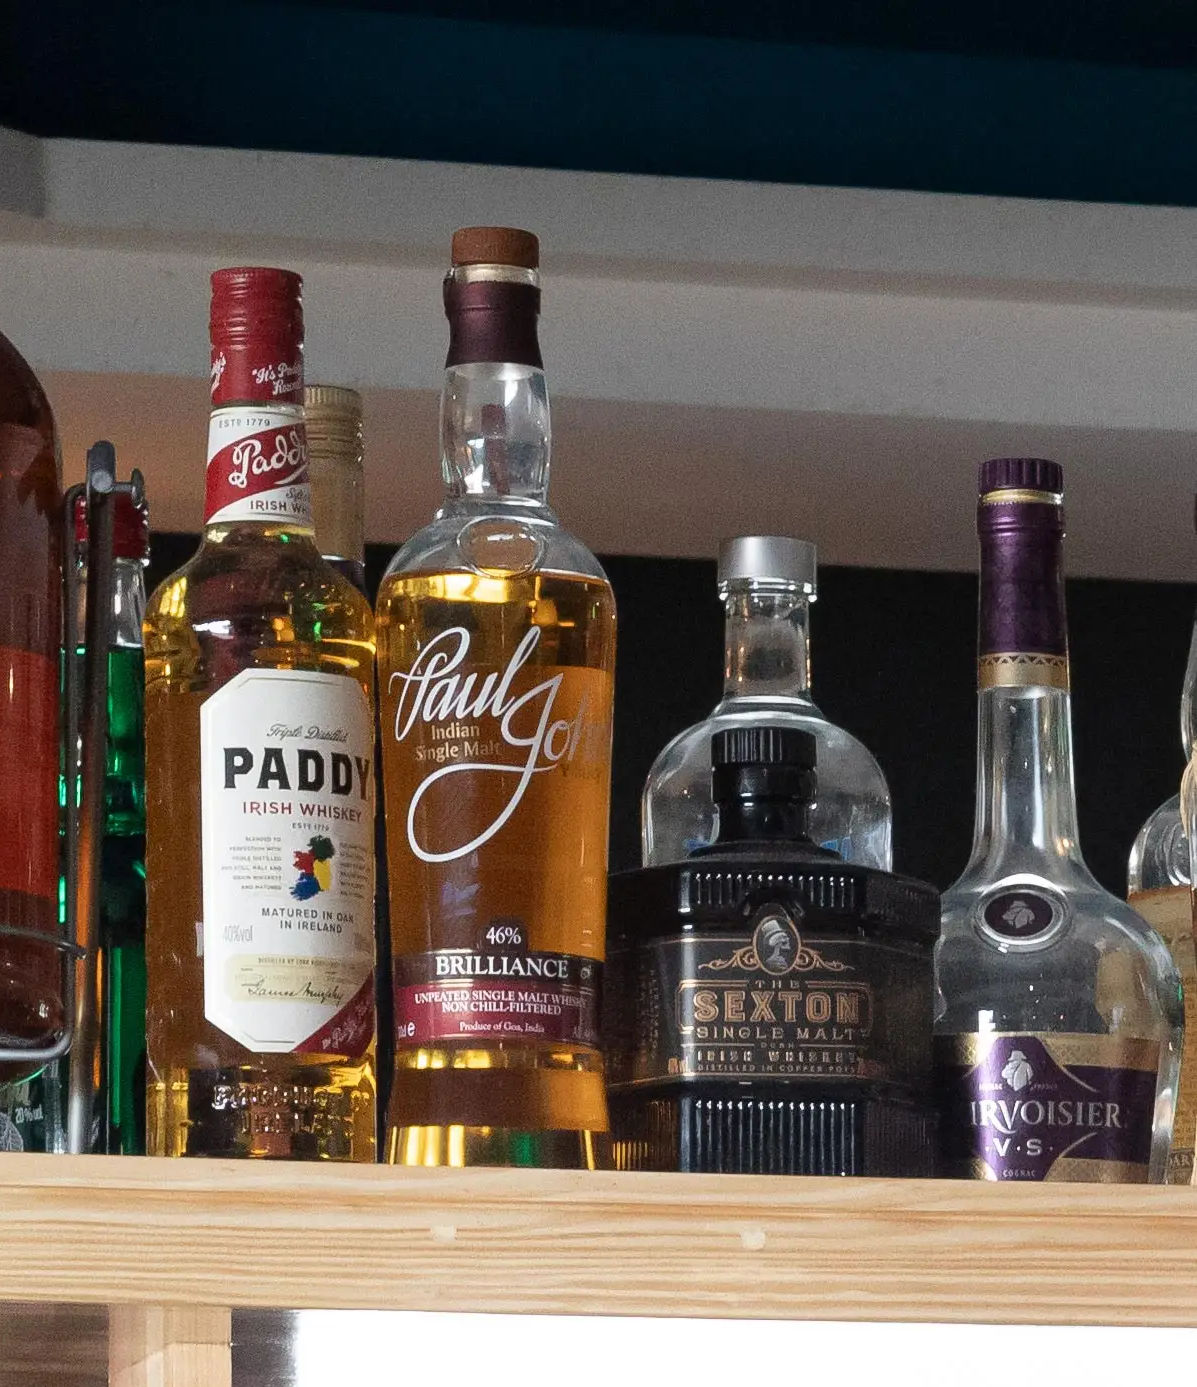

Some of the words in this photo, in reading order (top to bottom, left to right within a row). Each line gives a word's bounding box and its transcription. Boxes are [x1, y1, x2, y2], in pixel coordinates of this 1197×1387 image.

[246, 418, 271, 427] 1779
[250, 500, 287, 511] IRISH
[389, 626, 541, 742] Paul
[267, 723, 302, 741] Triple
[432, 723, 481, 741] Indian
[415, 745, 460, 763] Single
[463, 740, 504, 759] Malt
[223, 747, 371, 800] PADDY
[243, 801, 292, 816] IRISH
[299, 803, 363, 822] WHISKEY
[261, 907, 318, 919] MATURED
[322, 911, 333, 921] IN
[336, 912, 354, 924] OAK
[280, 918, 293, 929] IN
[297, 919, 343, 934] IRELAND
[485, 926, 522, 945] 46%
[435, 955, 569, 979] BRILLIANCE
[755, 979, 800, 989] THE
[414, 989, 470, 1005] UNPEATED
[472, 989, 515, 1002] SINGLE
[518, 991, 549, 1005] MALT
[442, 1001, 468, 1013] NON
[470, 1001, 562, 1016] CHILL-FILTERED
[693, 989, 861, 1025] SEXTON
[459, 1021, 492, 1033] Produce
[494, 1020, 503, 1031] of
[525, 1022, 545, 1034] India
[696, 1026, 785, 1040] SINGLE
[796, 1027, 855, 1041] MALT
[1002, 1168, 1037, 1178] COGNAC
